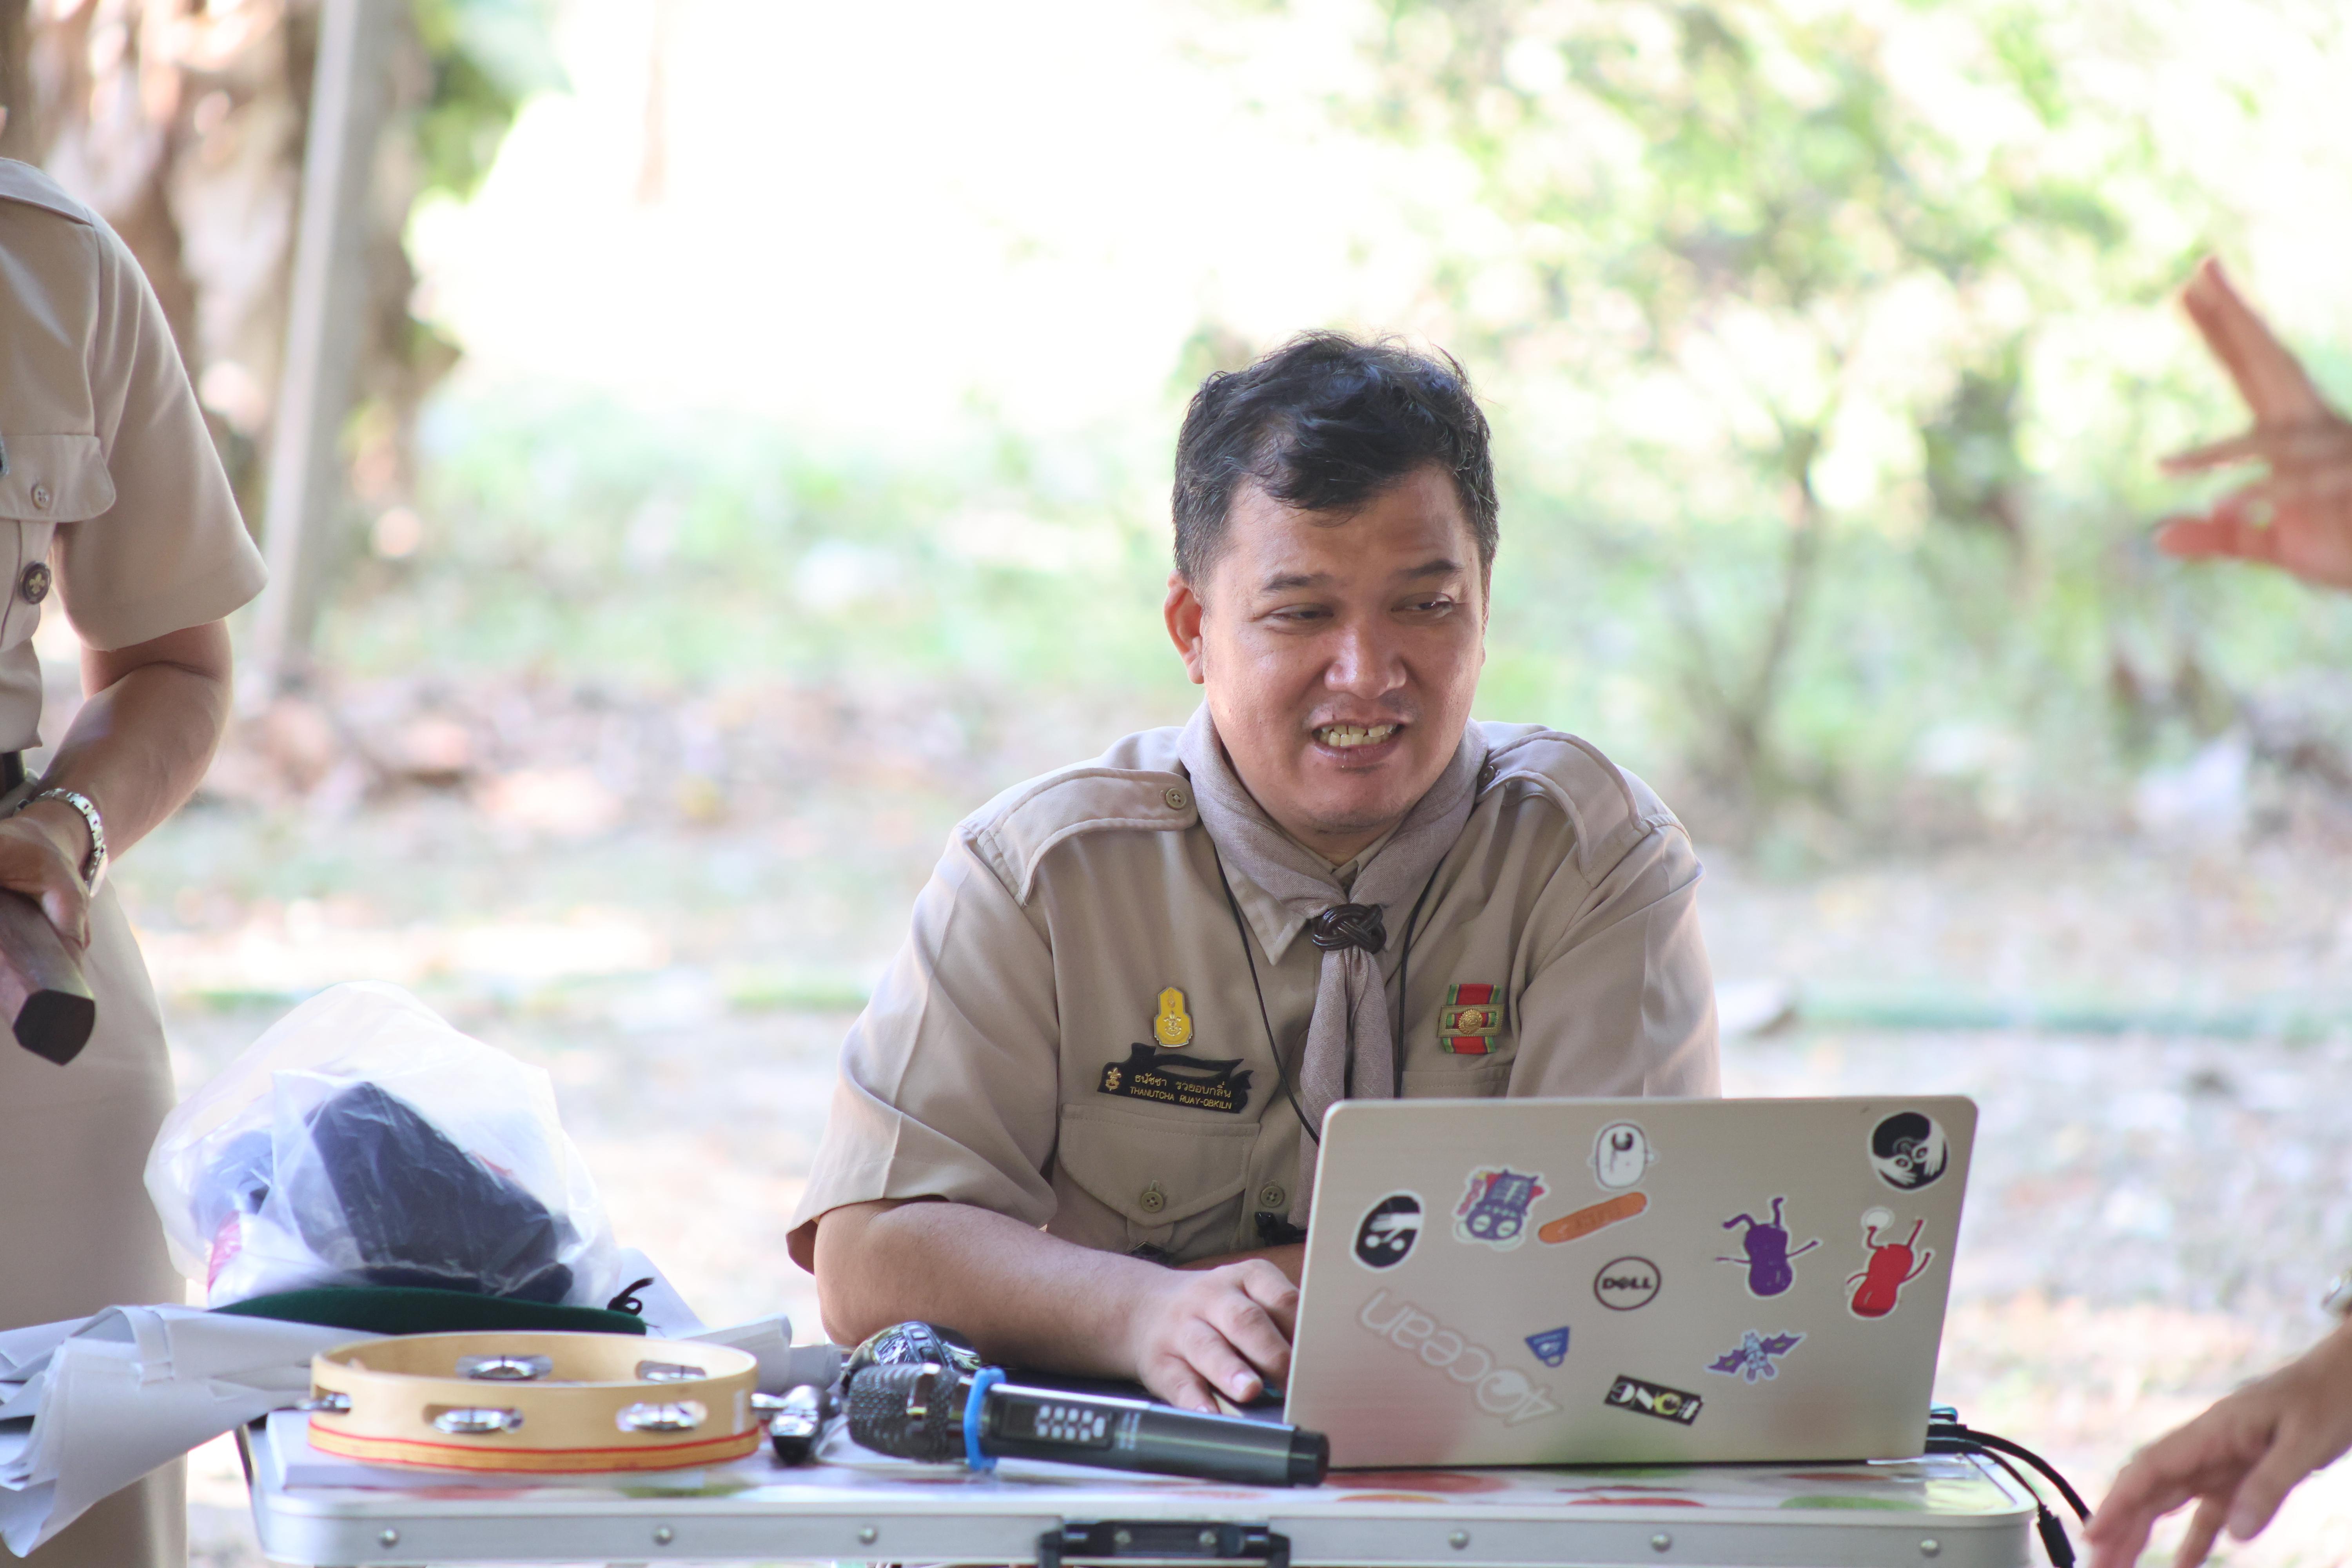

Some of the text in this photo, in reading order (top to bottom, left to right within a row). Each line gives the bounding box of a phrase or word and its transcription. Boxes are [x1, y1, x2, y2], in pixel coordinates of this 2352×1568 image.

[1134, 1073, 1232, 1098] ธนัชชา รวยอบกลิ่น
[1130, 1086, 1232, 1109] THANUTCHA RUAY-OBKILN
[1602, 1276, 1652, 1290] DELL
